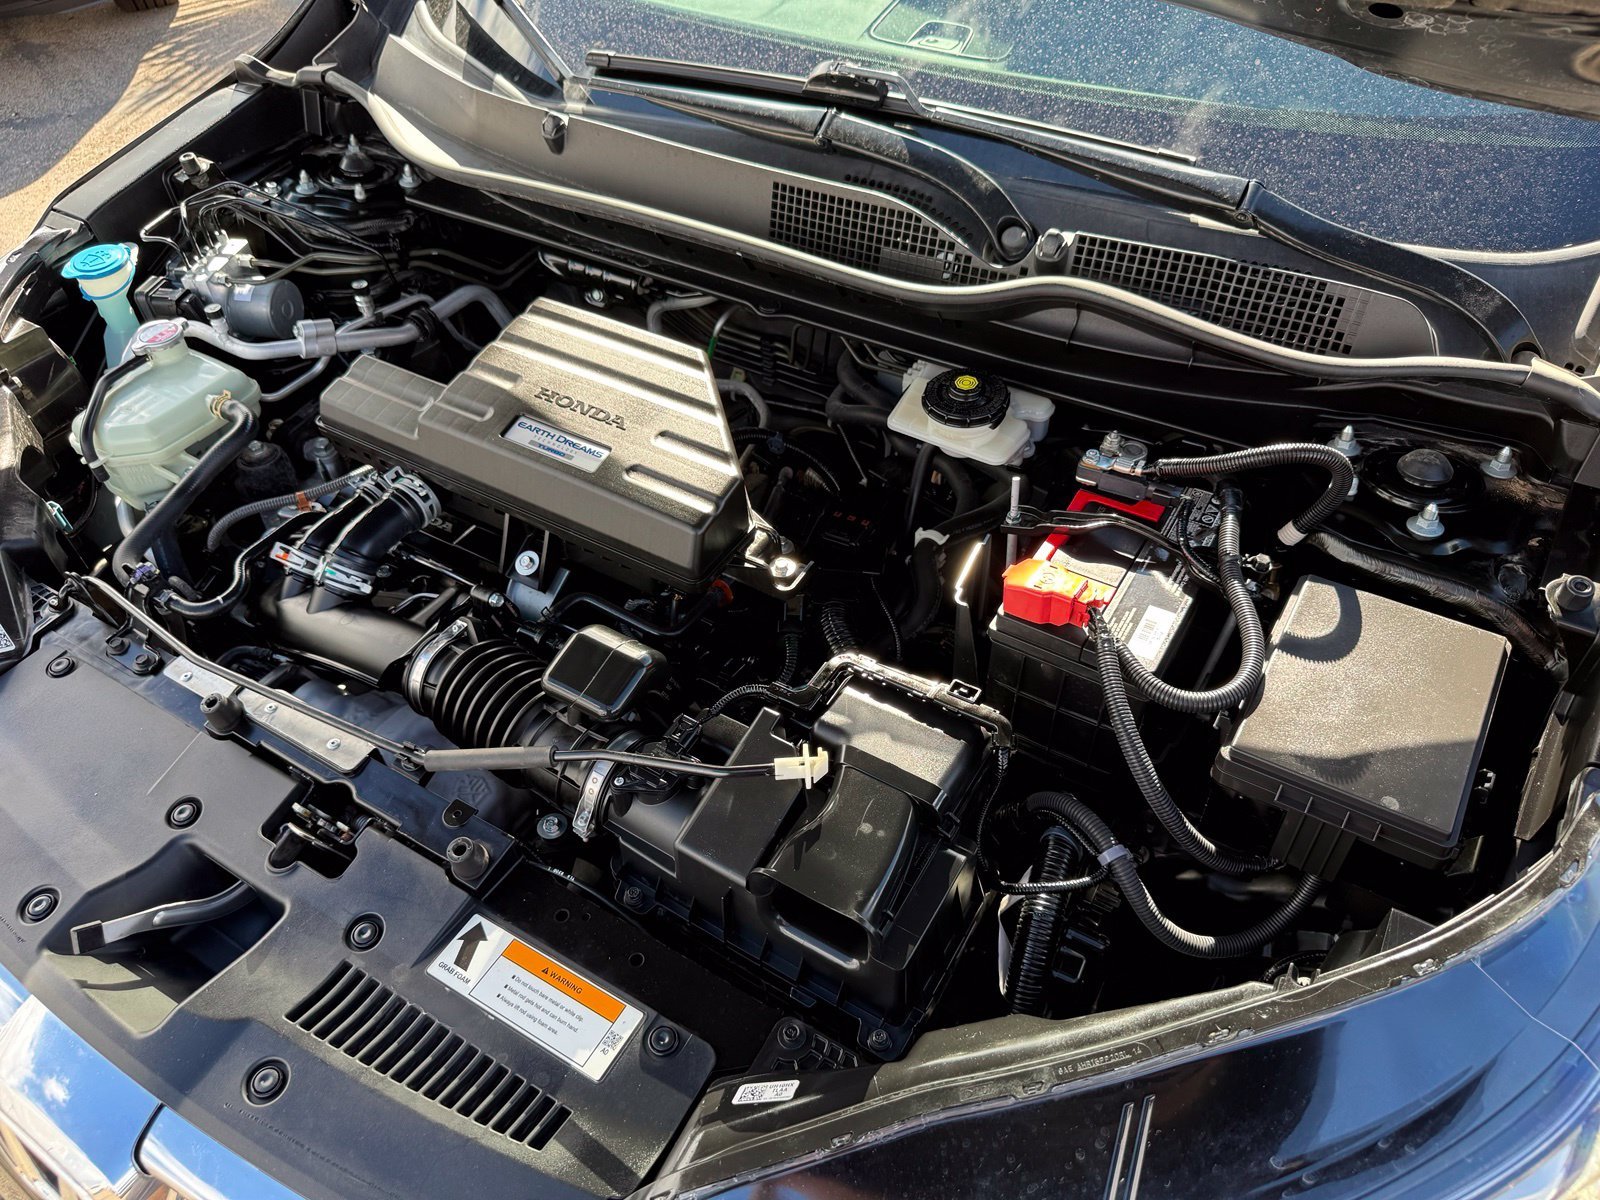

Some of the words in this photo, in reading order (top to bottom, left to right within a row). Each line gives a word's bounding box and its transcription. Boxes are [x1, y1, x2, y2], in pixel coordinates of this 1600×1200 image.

[534, 386, 626, 431] HONDA
[517, 421, 556, 440] EARTH
[556, 434, 604, 459] DREAMS
[538, 444, 566, 457] TURBO
[438, 961, 454, 974] GRAB
[453, 971, 471, 984] FOAM
[550, 971, 583, 994] WARNING
[500, 996, 514, 1008] Always
[526, 1013, 538, 1023] using
[537, 1018, 548, 1028] foam
[507, 986, 518, 996] Metal
[518, 992, 526, 1000] rod
[524, 998, 534, 1006] gets
[534, 1002, 542, 1010] hot
[557, 1016, 567, 1026] burn
[528, 984, 540, 994] touch
[539, 992, 548, 1000] bare
[550, 997, 560, 1006] metal
[564, 1006, 576, 1016] white
